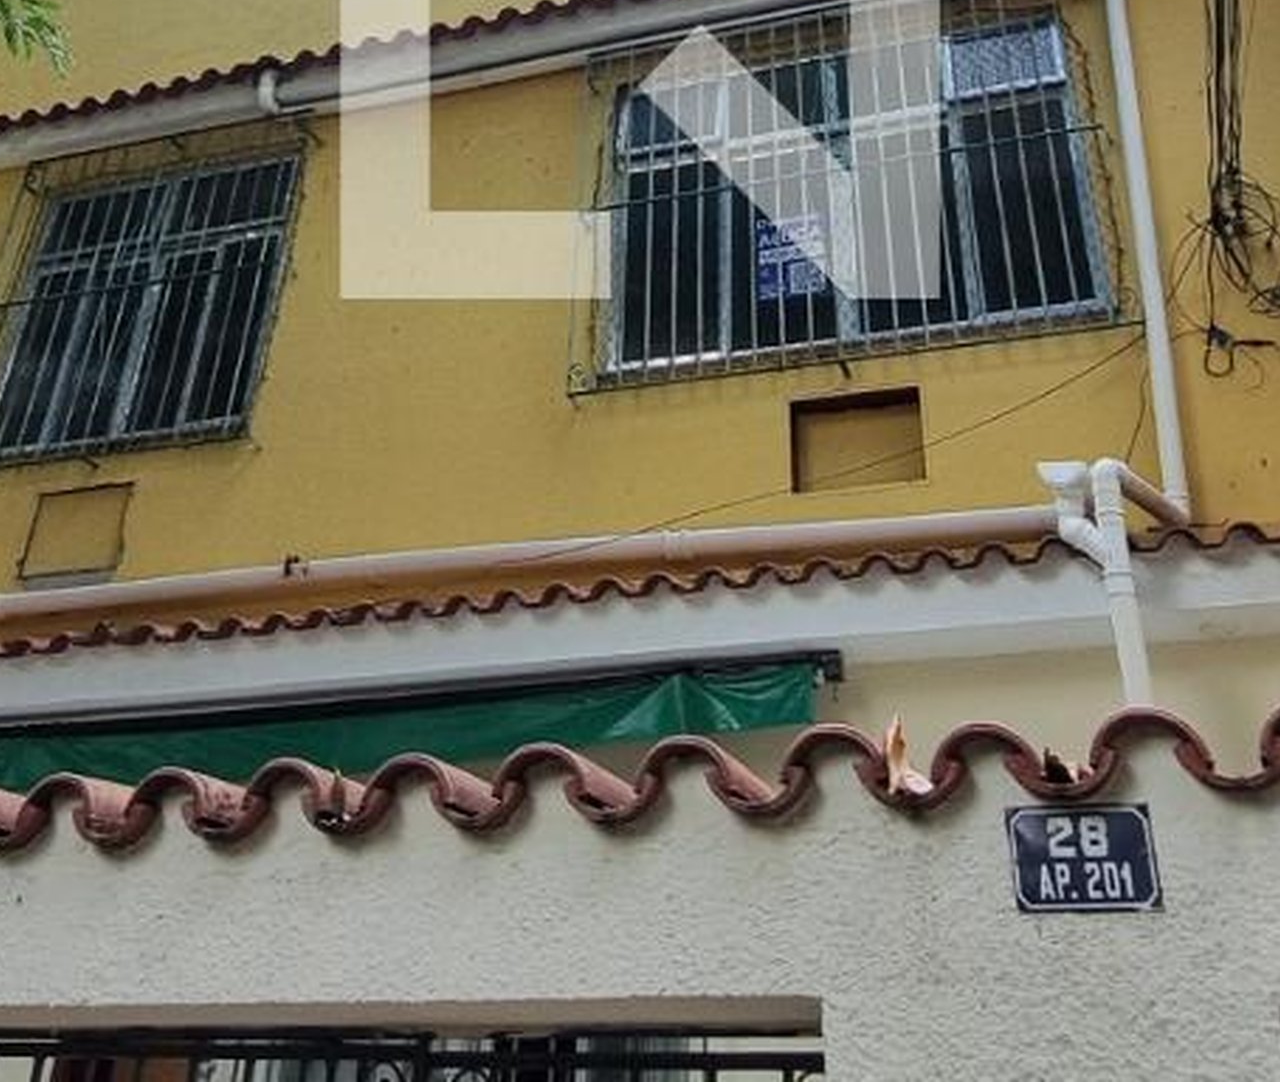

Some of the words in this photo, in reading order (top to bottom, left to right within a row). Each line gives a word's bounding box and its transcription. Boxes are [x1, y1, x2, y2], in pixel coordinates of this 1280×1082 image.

[1046, 816, 1109, 858] 28
[1040, 862, 1079, 900] AP.
[1085, 861, 1135, 900] 201
